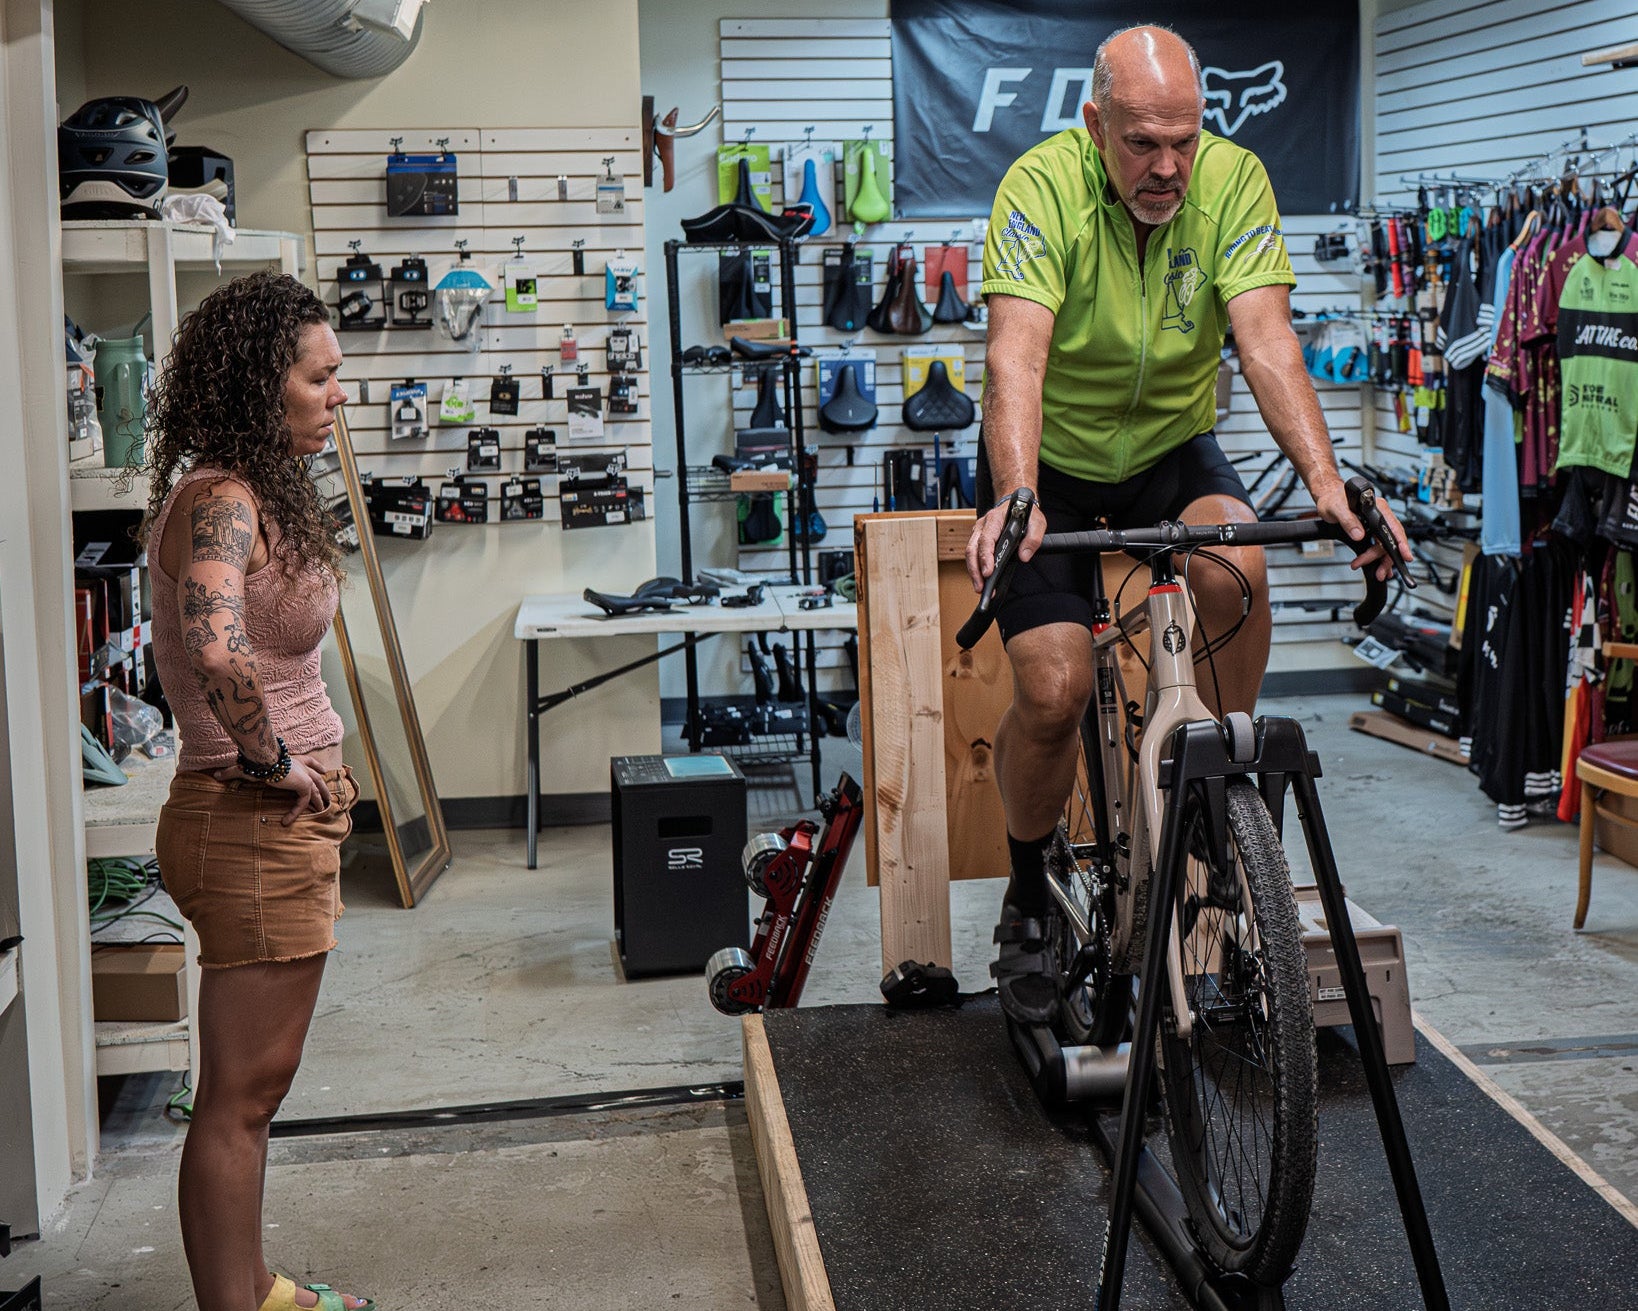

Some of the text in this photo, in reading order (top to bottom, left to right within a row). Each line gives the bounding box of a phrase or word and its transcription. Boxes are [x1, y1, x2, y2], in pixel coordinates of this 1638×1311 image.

[973, 68, 1093, 132] FO
[1225, 235, 1246, 259] RIDING
[1246, 230, 1256, 240] TO
[1256, 225, 1273, 236] BEAT
[668, 848, 703, 864] SR
[766, 914, 787, 961] FEEDBACK
[805, 896, 832, 965] FEEDBACK
